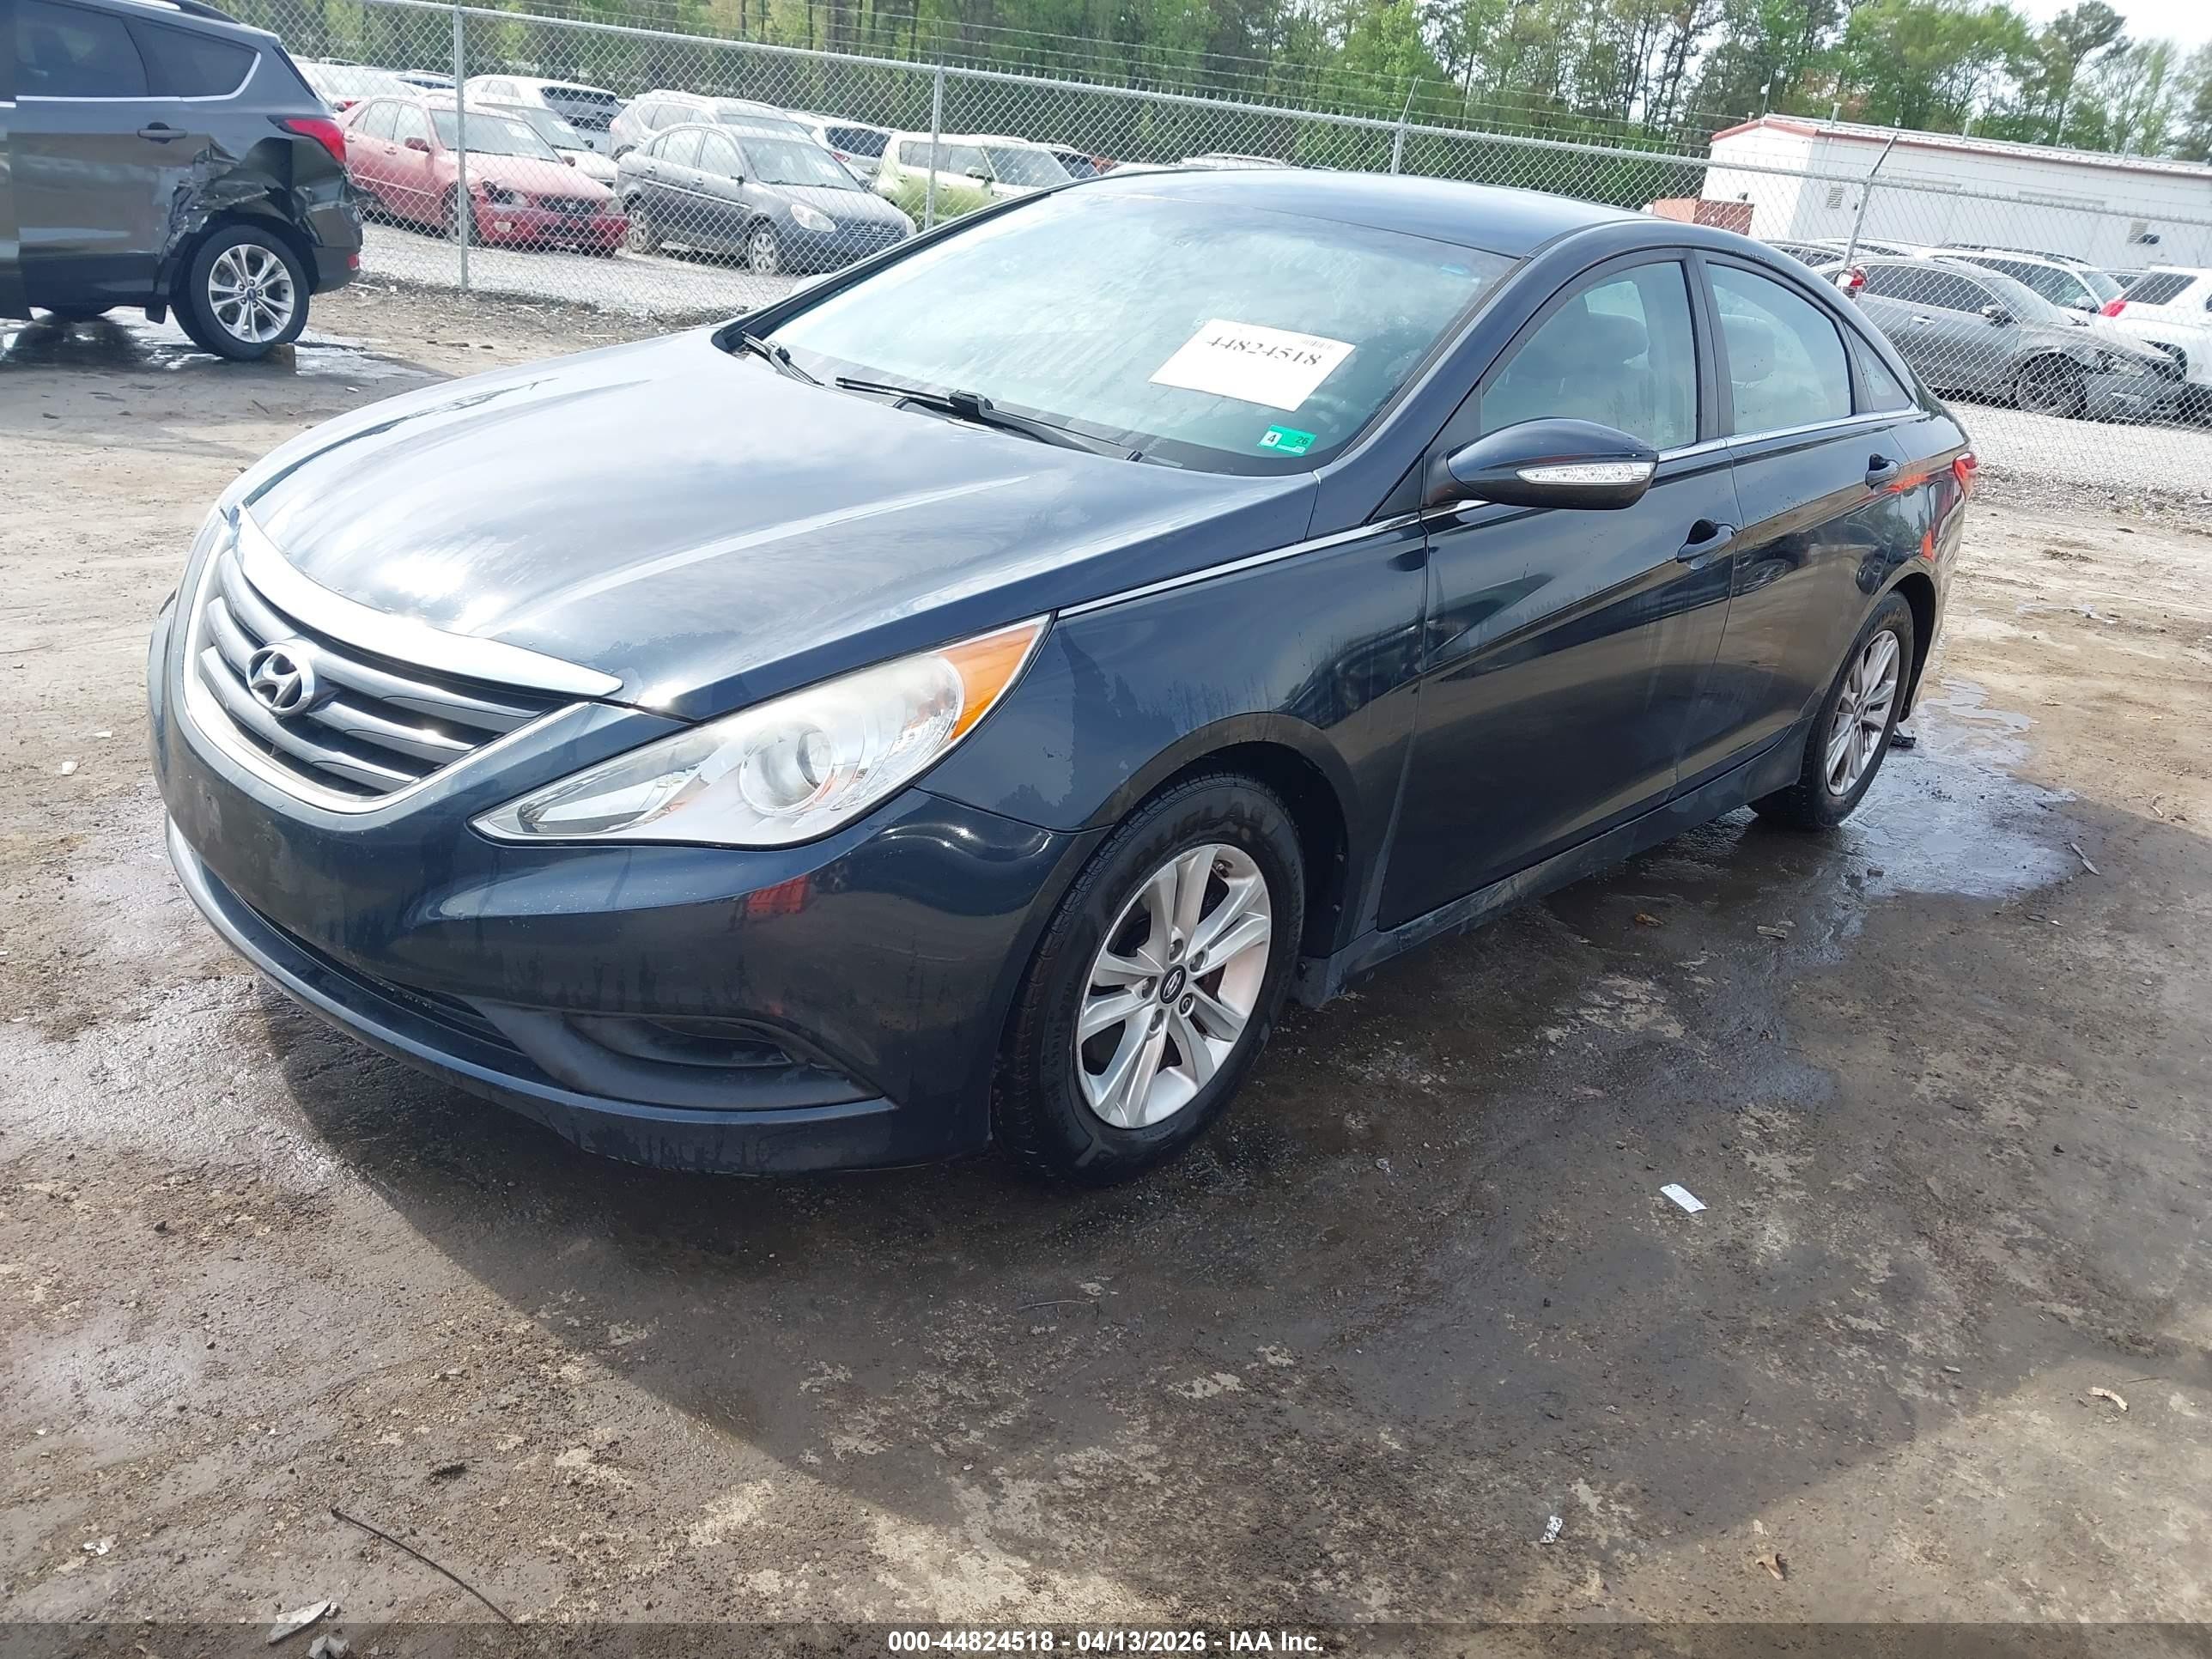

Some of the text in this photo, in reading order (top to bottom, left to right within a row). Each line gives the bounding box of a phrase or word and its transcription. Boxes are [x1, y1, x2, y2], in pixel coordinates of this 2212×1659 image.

[1207, 336, 1322, 366] 44824518
[1267, 434, 1277, 443] 4
[1296, 435, 1310, 446] 26
